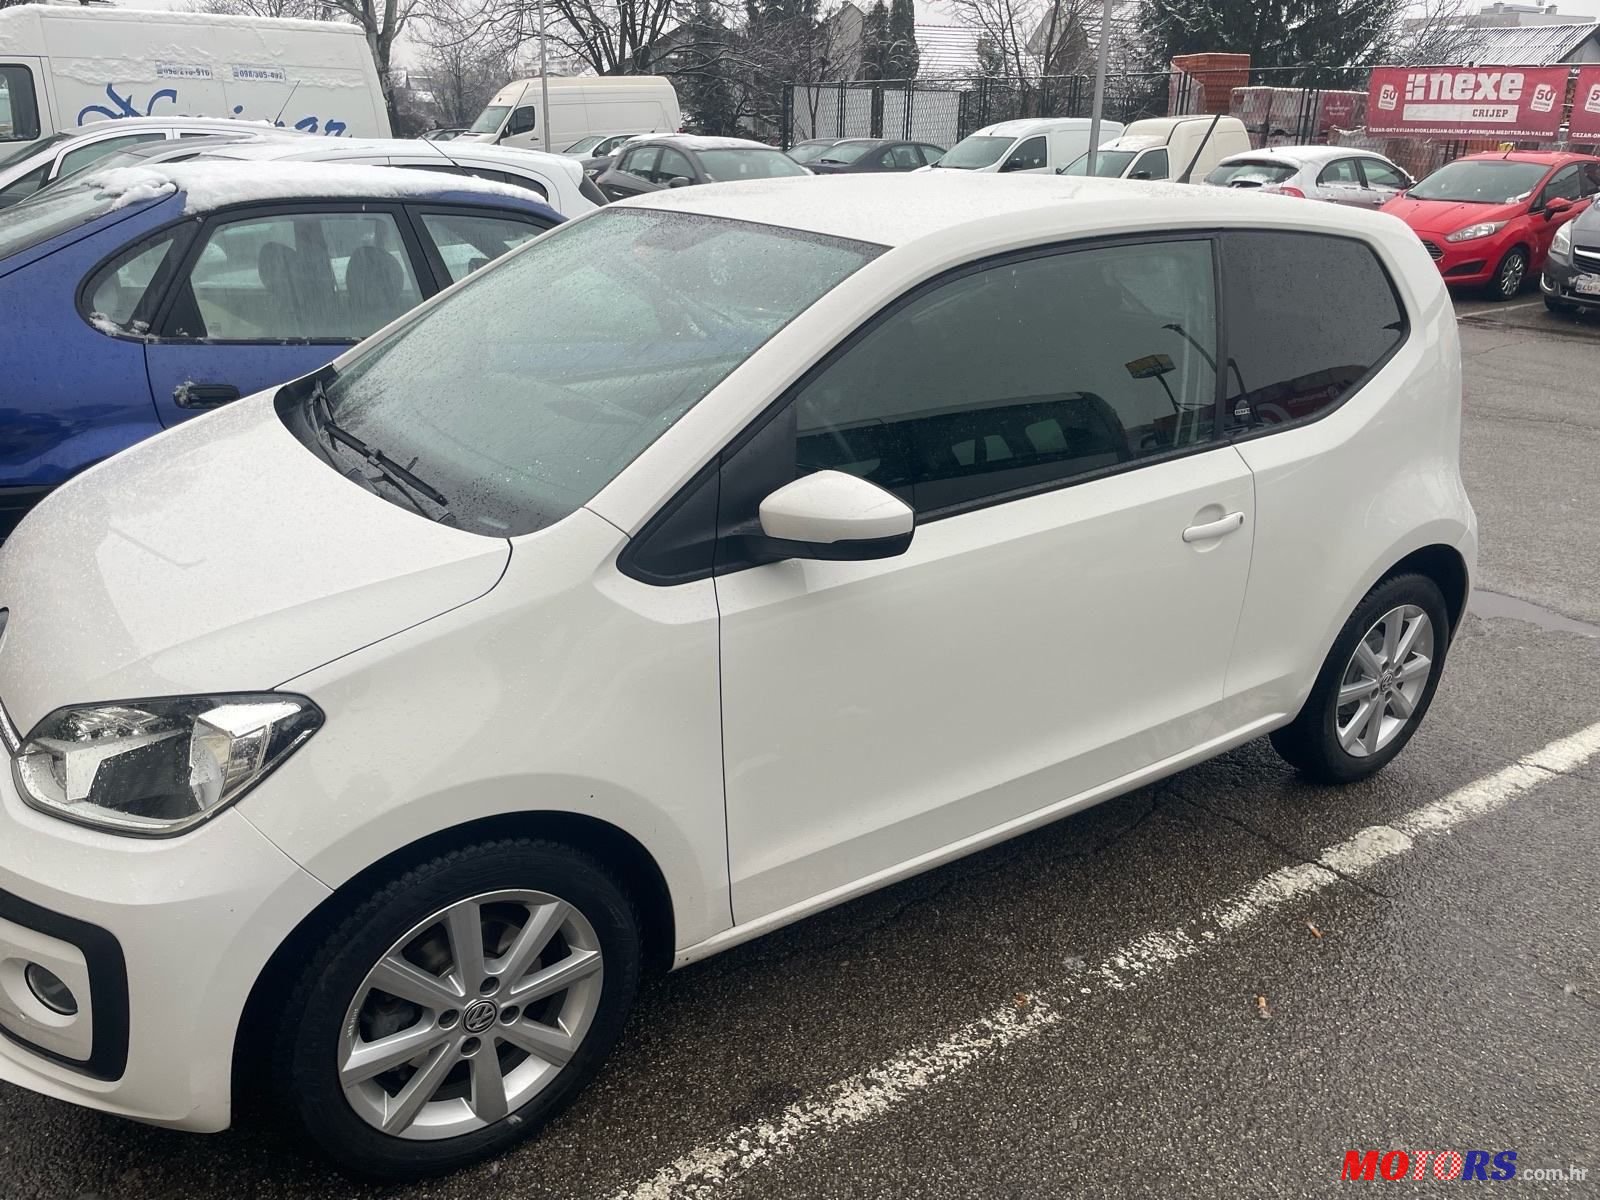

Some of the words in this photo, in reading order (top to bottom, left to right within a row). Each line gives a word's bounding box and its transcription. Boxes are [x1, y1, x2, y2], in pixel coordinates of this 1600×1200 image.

[1429, 72, 1525, 100] nexe
[1382, 89, 1396, 101] 50
[1535, 89, 1553, 101] 50
[1591, 89, 1600, 101] 5
[1472, 109, 1509, 118] CRIJEP
